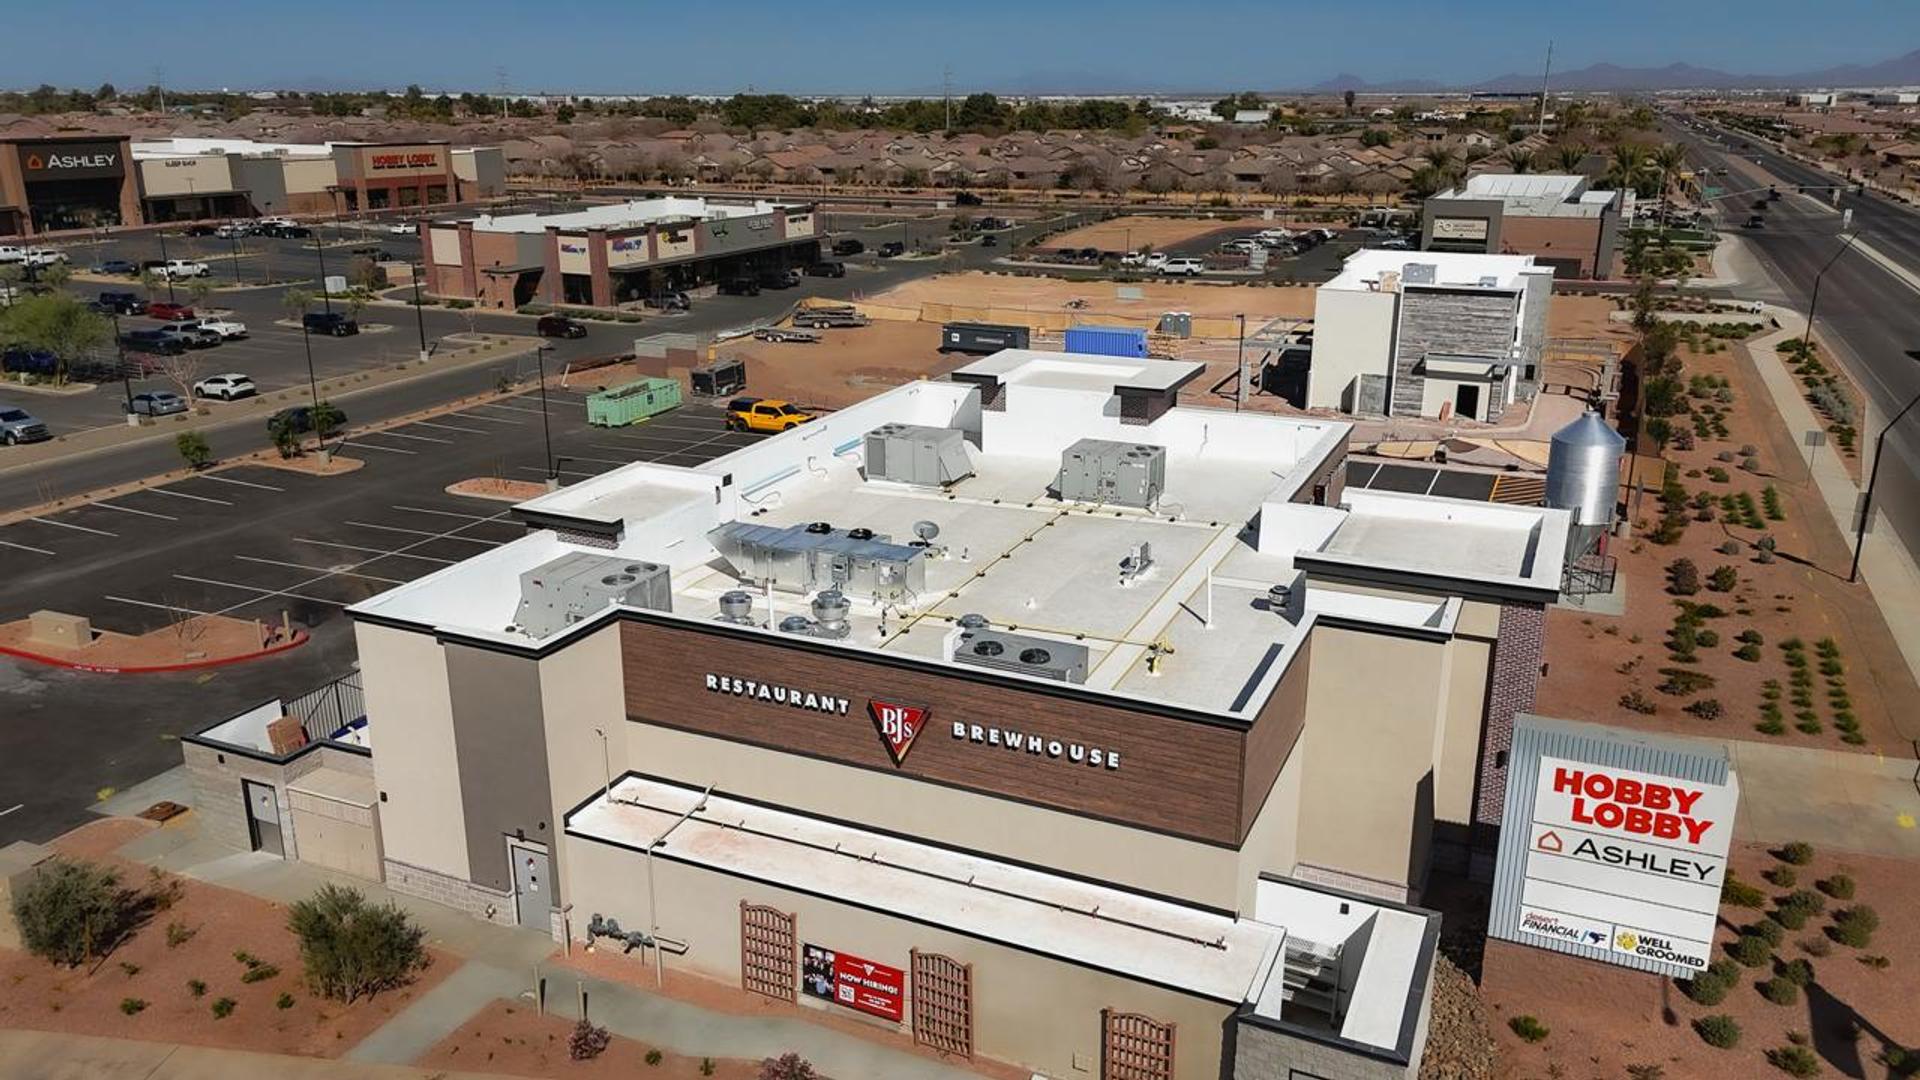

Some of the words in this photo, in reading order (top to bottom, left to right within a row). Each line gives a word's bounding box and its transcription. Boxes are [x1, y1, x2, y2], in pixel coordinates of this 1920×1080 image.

[48, 154, 116, 169] ASHLEY
[706, 674, 850, 714] RESTAURANT
[882, 708, 914, 743] BJ's
[952, 721, 1120, 769] BREWHOUSE
[1553, 767, 1704, 815] HOBBY
[1571, 797, 1714, 844] LOBBY
[1572, 838, 1715, 881] ASHLEY
[1522, 919, 1579, 940] FINANCIAL
[1525, 911, 1560, 924] desert
[1636, 944, 1705, 968] GROOMED
[1638, 934, 1673, 951] WELL
